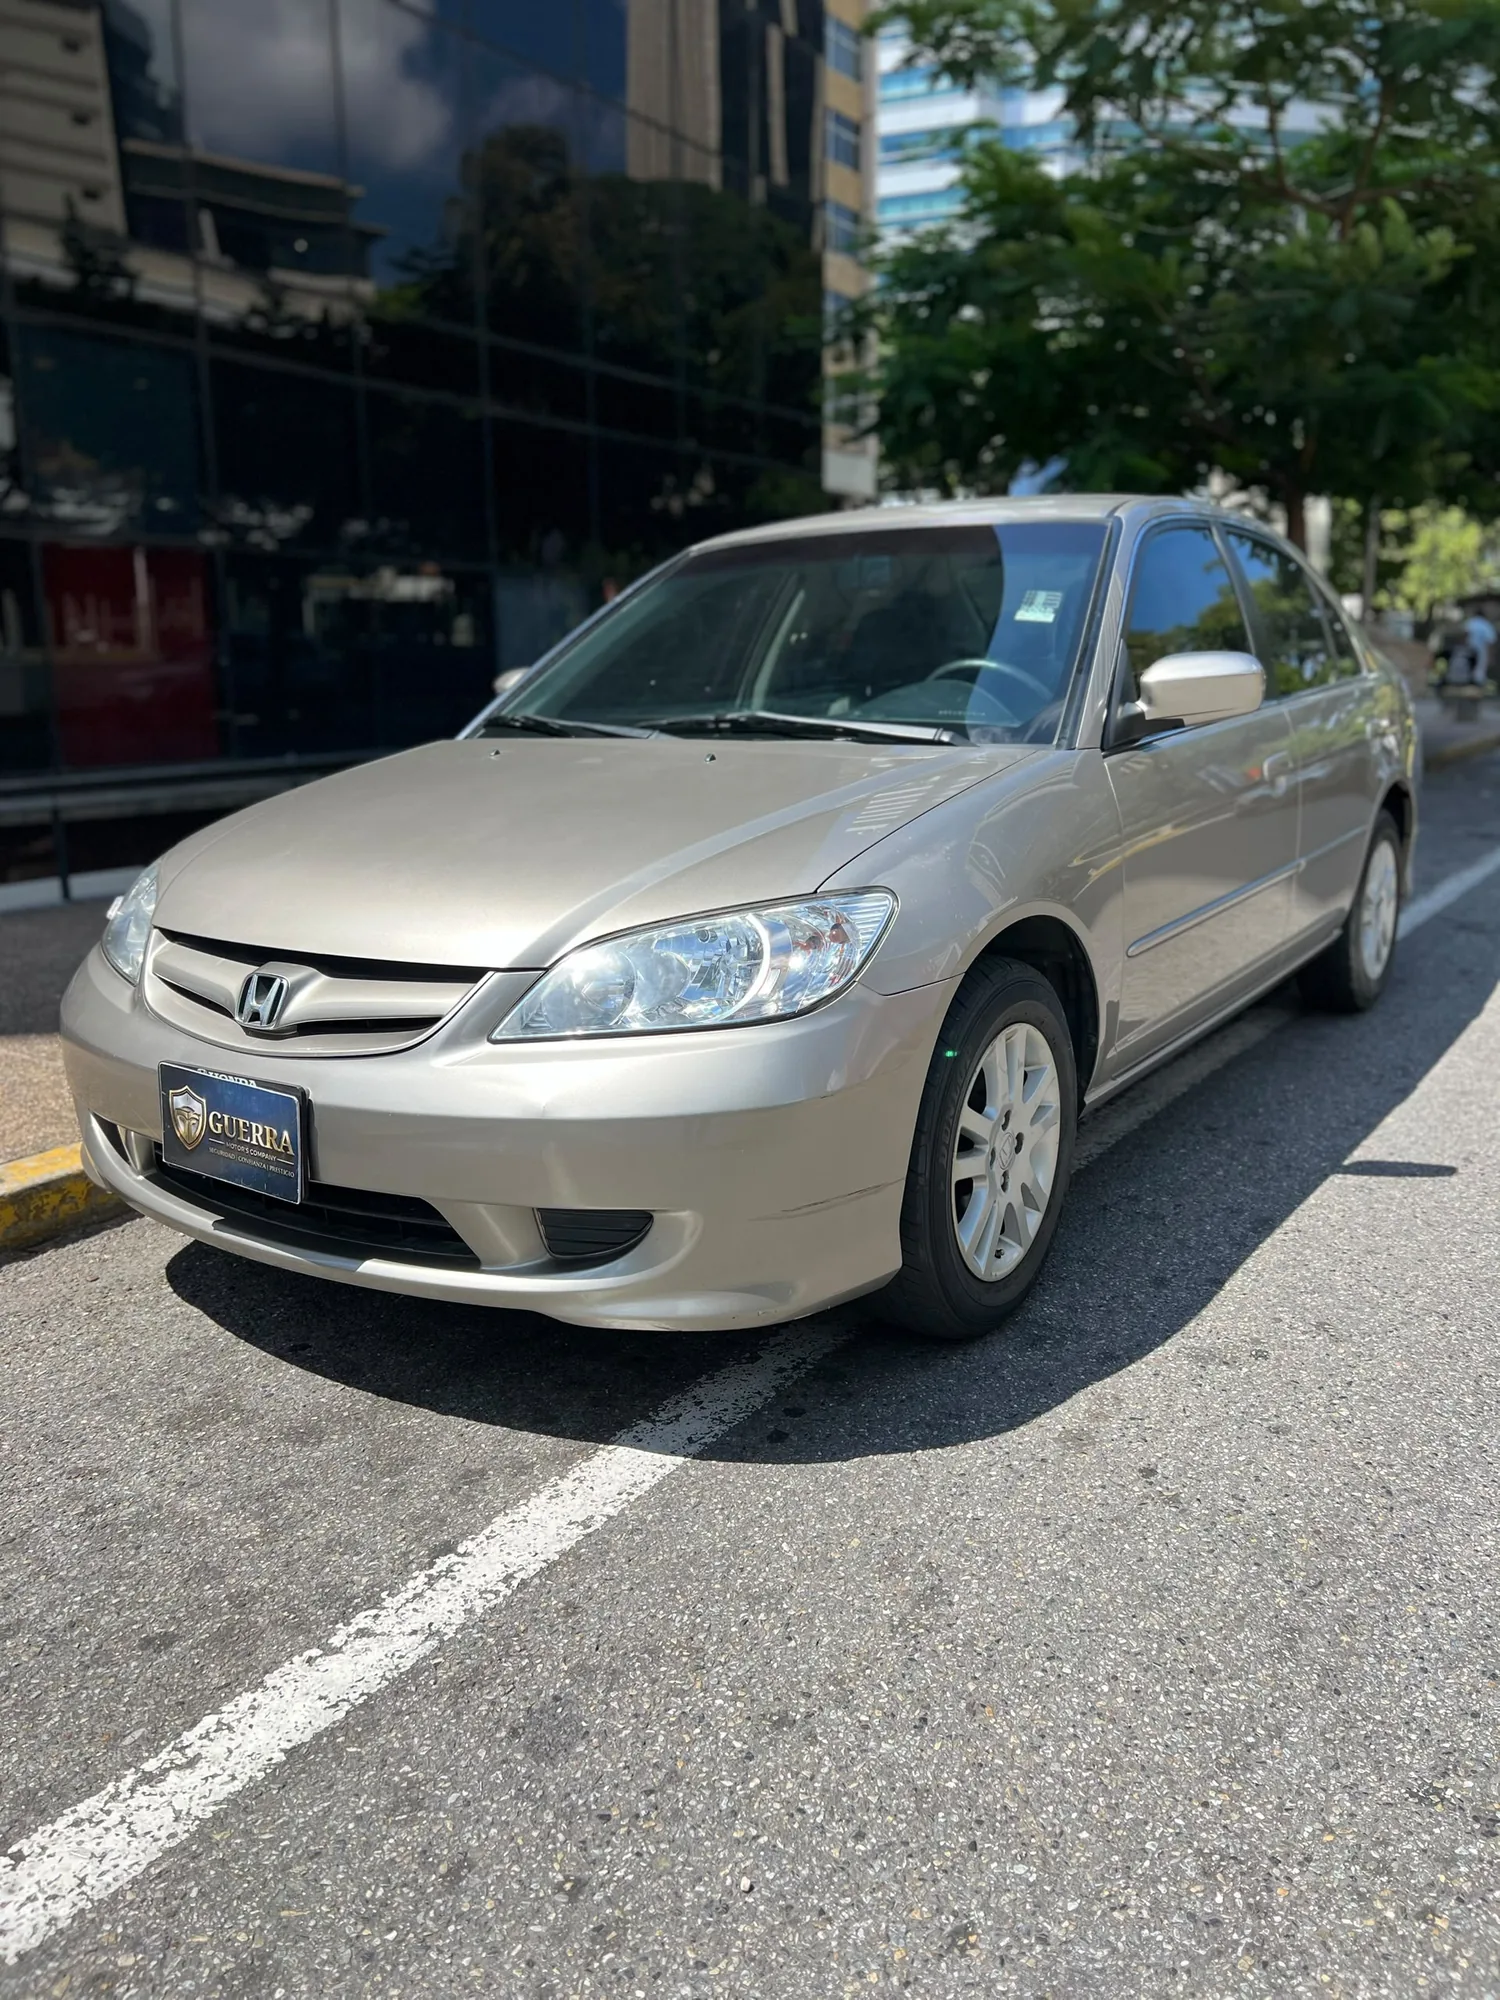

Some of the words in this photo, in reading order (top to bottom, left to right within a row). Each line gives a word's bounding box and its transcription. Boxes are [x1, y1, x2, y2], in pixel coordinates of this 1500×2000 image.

[209, 1111, 295, 1155] GUERRA
[238, 1155, 267, 1169] CONFIANZA
[250, 1149, 277, 1162] COMPANY
